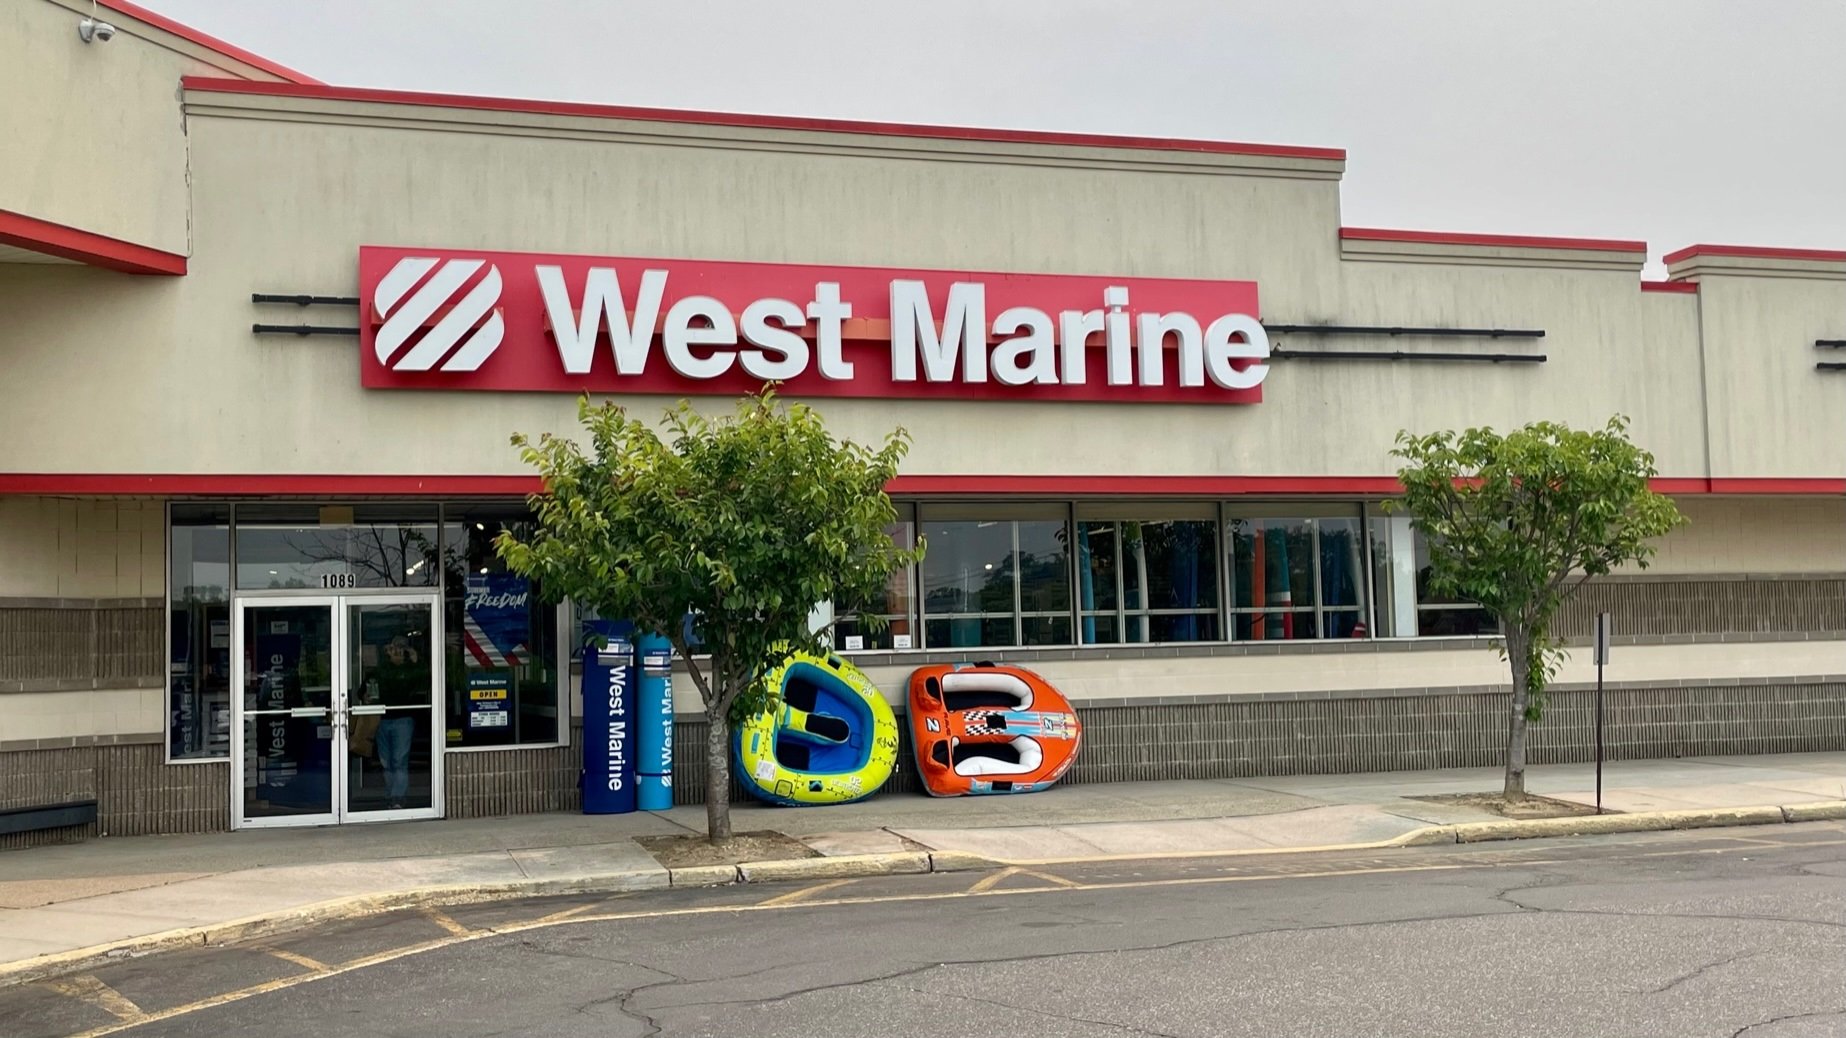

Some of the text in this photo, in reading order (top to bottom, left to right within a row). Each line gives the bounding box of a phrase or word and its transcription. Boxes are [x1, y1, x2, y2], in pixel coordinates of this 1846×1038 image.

[535, 264, 1271, 390] West Marine
[322, 574, 354, 588] 1089
[465, 592, 528, 610] FREEDOM
[181, 726, 192, 753] est
[609, 665, 626, 790] West Marine
[661, 719, 672, 766] West
